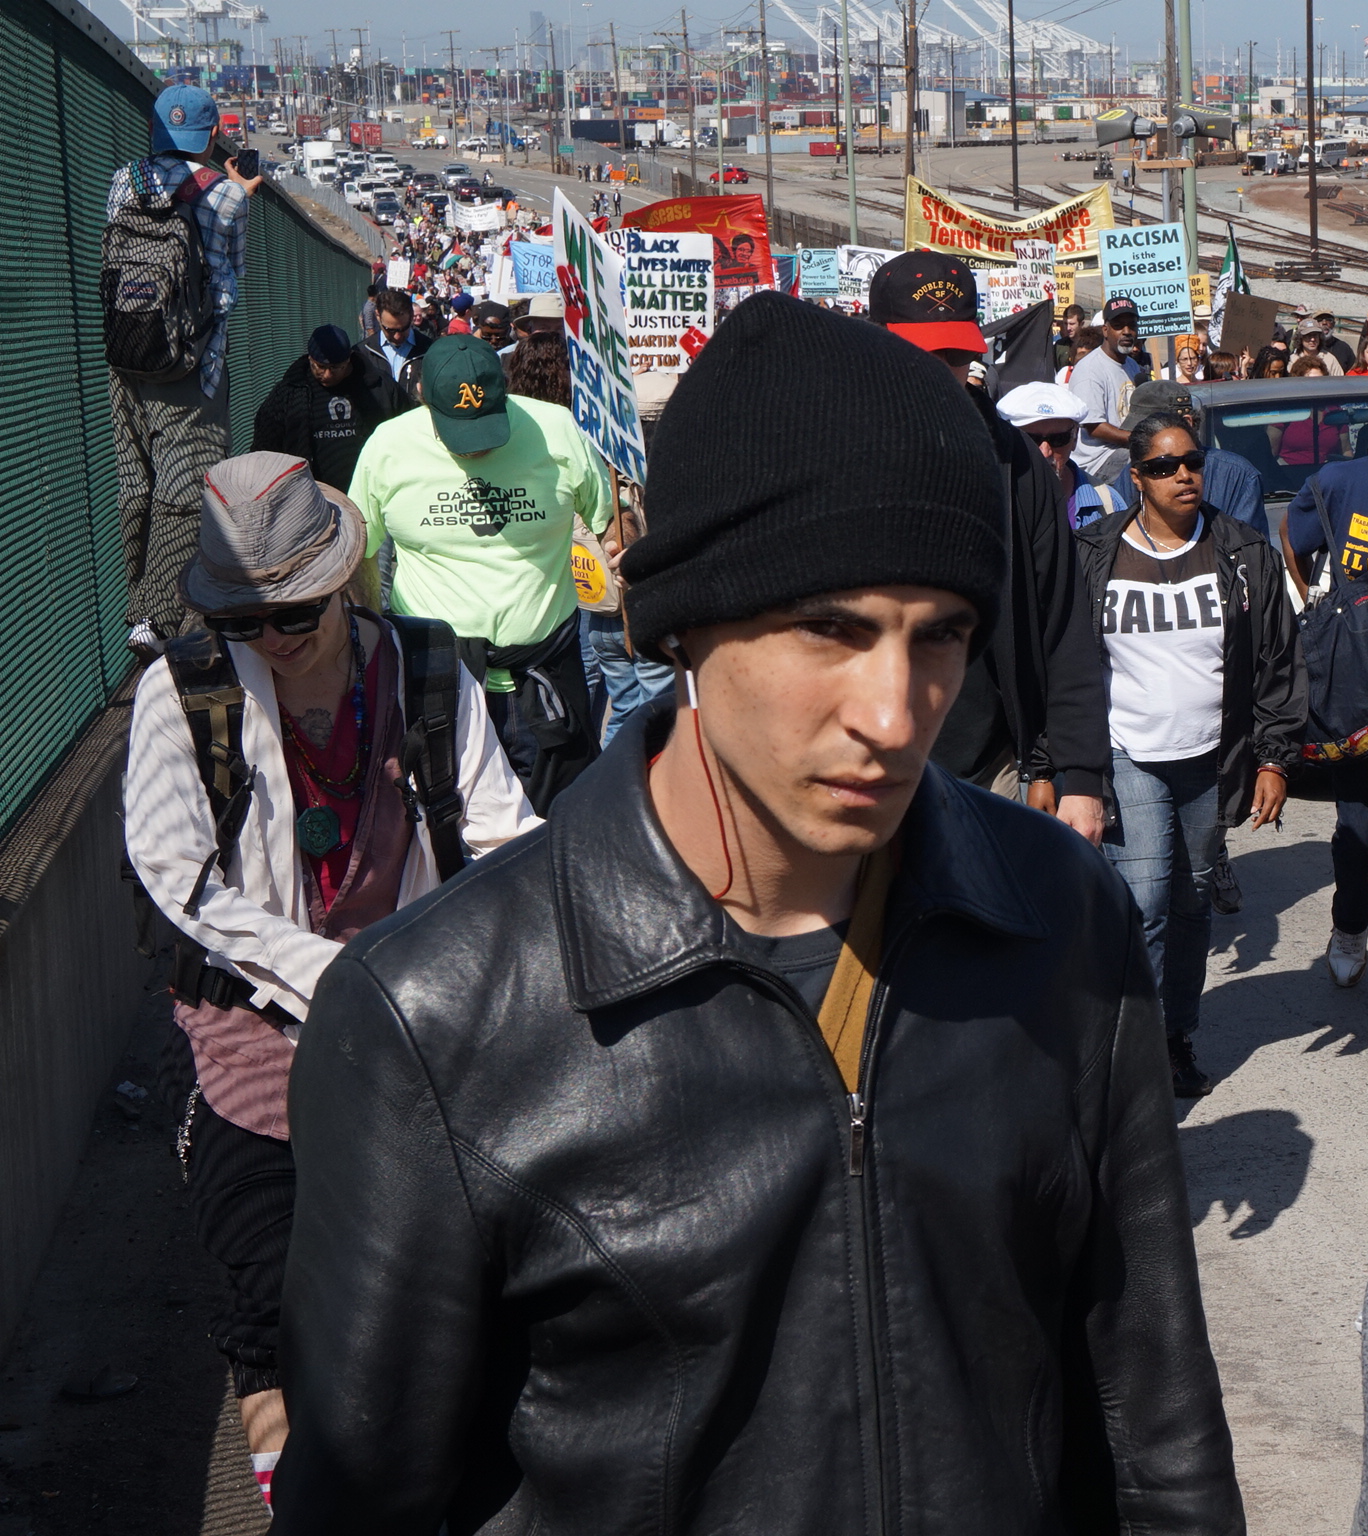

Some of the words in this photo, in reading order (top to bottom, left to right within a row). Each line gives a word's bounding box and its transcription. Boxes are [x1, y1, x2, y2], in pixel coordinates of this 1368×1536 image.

[921, 196, 968, 225] STOP
[626, 232, 680, 253] BLACK
[929, 221, 984, 250] Terror
[987, 234, 1006, 252] in
[1106, 228, 1180, 250] RACISM
[523, 252, 553, 268] STOP
[1015, 247, 1050, 260] INJURY
[1132, 252, 1140, 260] is
[1141, 251, 1156, 259] the
[627, 257, 668, 271] LIVES
[669, 258, 712, 273] MATTER
[802, 257, 835, 271] Socialism
[1031, 262, 1053, 275] ONE
[1108, 256, 1182, 277] Disease!
[522, 268, 558, 289] BLACK
[627, 273, 657, 288] ALL
[661, 273, 707, 288] LIVES
[1060, 271, 1074, 279] war
[911, 280, 945, 301] DOUBLE
[946, 282, 964, 299] PLAY
[935, 290, 946, 298] SF
[1002, 289, 1021, 300] ONE
[1110, 283, 1185, 299] REVOLUTION
[630, 289, 707, 312] MATTER
[1150, 299, 1178, 311] Cure!
[628, 315, 691, 329] JUSTICE
[697, 315, 706, 328] 4
[628, 335, 677, 348] MARTIN
[630, 354, 681, 367] COTTON
[453, 382, 486, 409] A's
[567, 336, 639, 442] OSCAR
[572, 384, 646, 487] GRANT
[437, 486, 528, 502] OAKLAND
[428, 499, 537, 514] EDUCATION
[419, 510, 547, 527] ASSOCIATION
[574, 570, 589, 579] 1021
